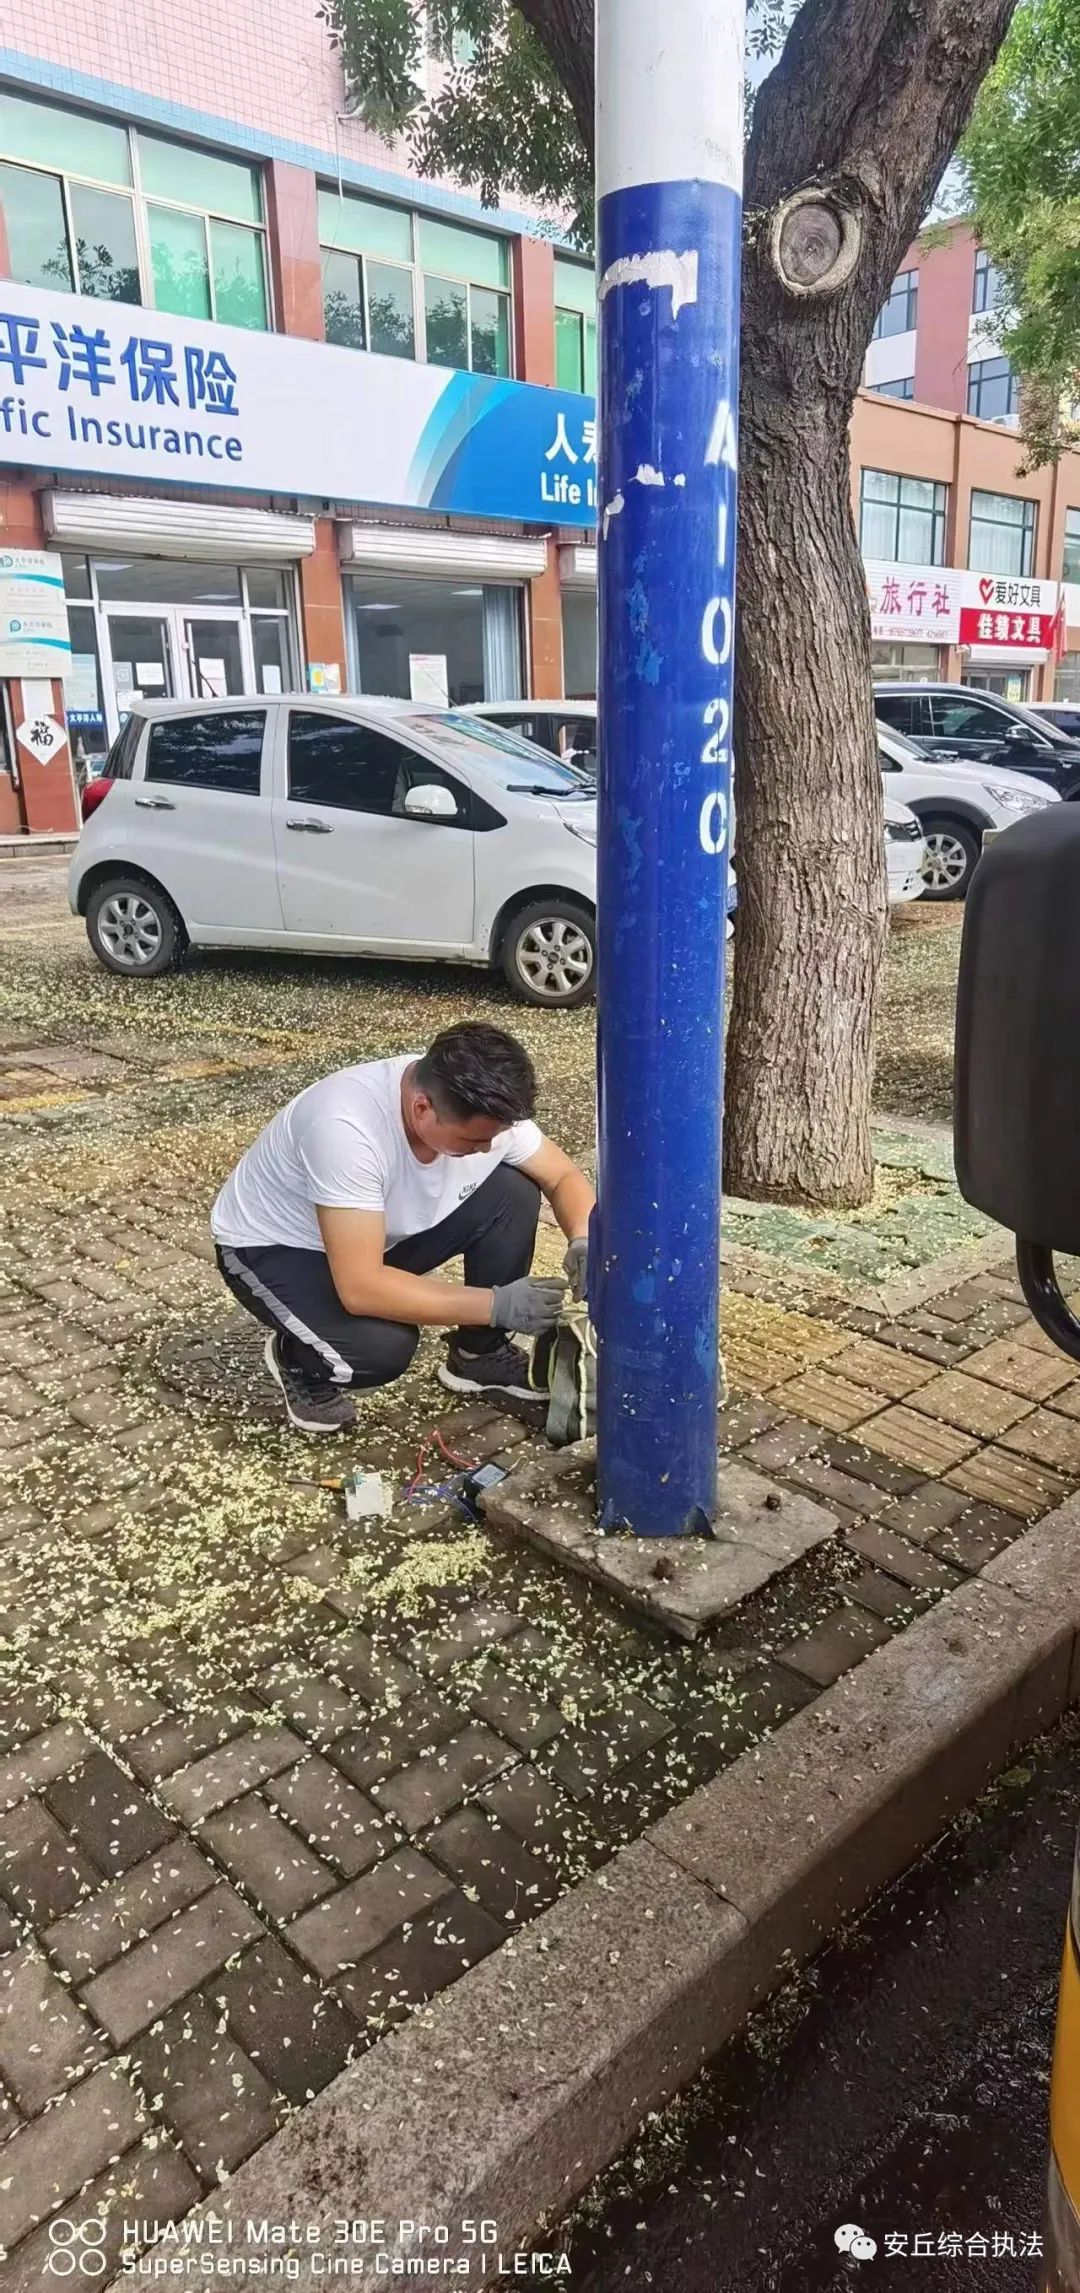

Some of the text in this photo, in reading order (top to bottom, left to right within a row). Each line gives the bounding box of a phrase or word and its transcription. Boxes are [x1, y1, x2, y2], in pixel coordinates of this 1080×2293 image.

[0, 312, 239, 416] 平洋保险
[68, 406, 243, 462] Insurance
[540, 471, 598, 507] Life I
[880, 576, 950, 618] 旅行社
[995, 581, 1041, 607] 爱好文具
[30, 720, 54, 747] 福
